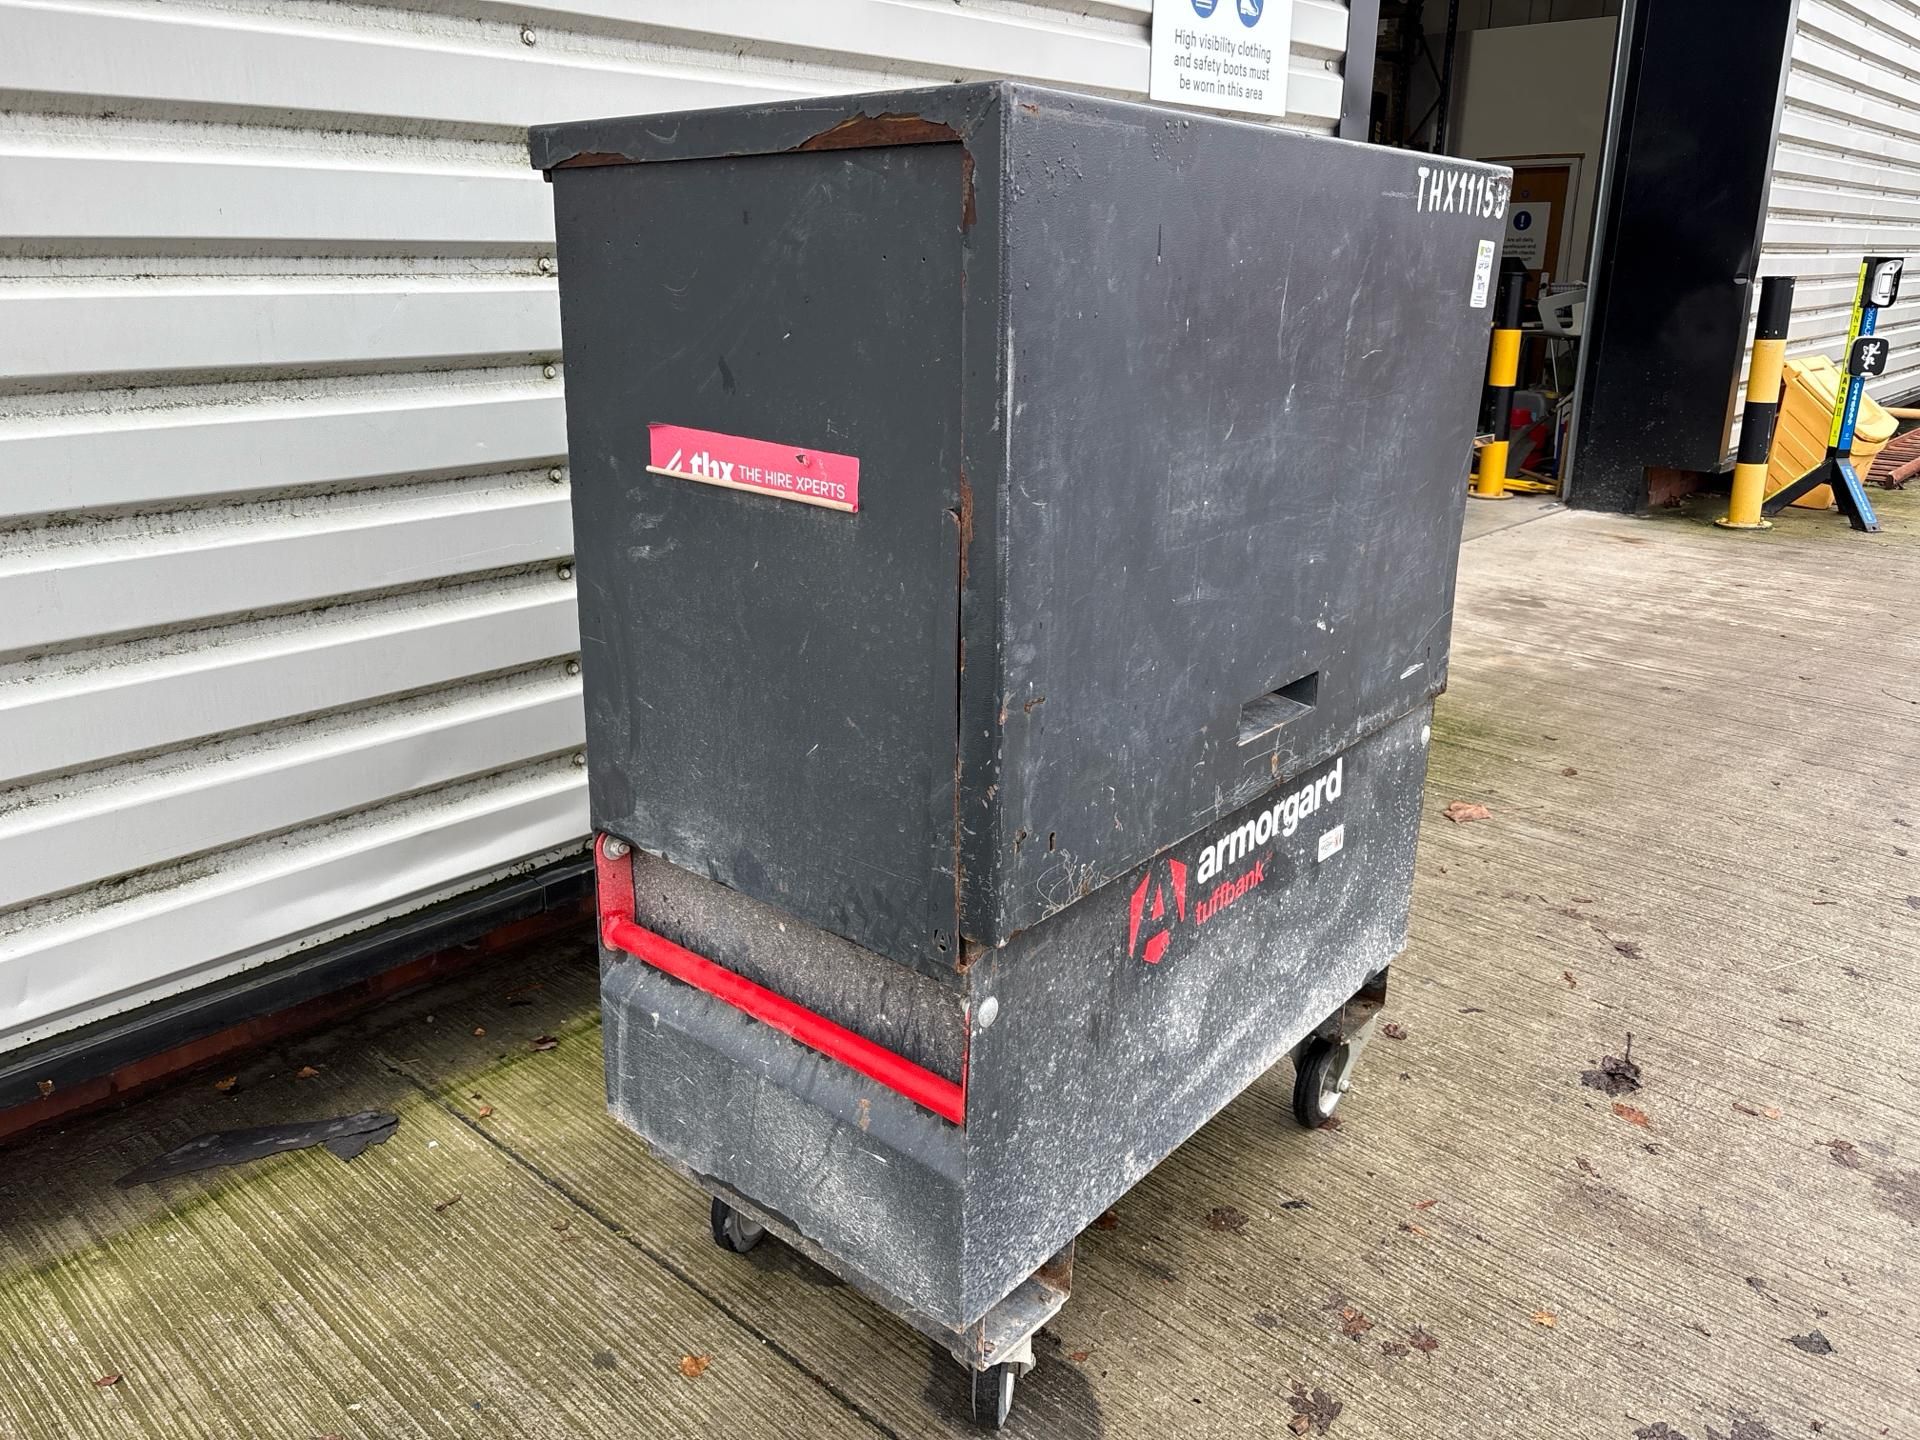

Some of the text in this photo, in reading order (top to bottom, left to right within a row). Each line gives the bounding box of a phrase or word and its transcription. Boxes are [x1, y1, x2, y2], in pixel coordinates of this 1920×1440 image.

[1174, 53, 1270, 81] and safety boots must
[1175, 29, 1271, 64] High visibility clothing
[1179, 74, 1263, 100] be worn in this area
[689, 451, 846, 500] thx THE HIRE XPERTS
[1197, 757, 1343, 884] armorgard
[1196, 859, 1264, 926] tuffbank
